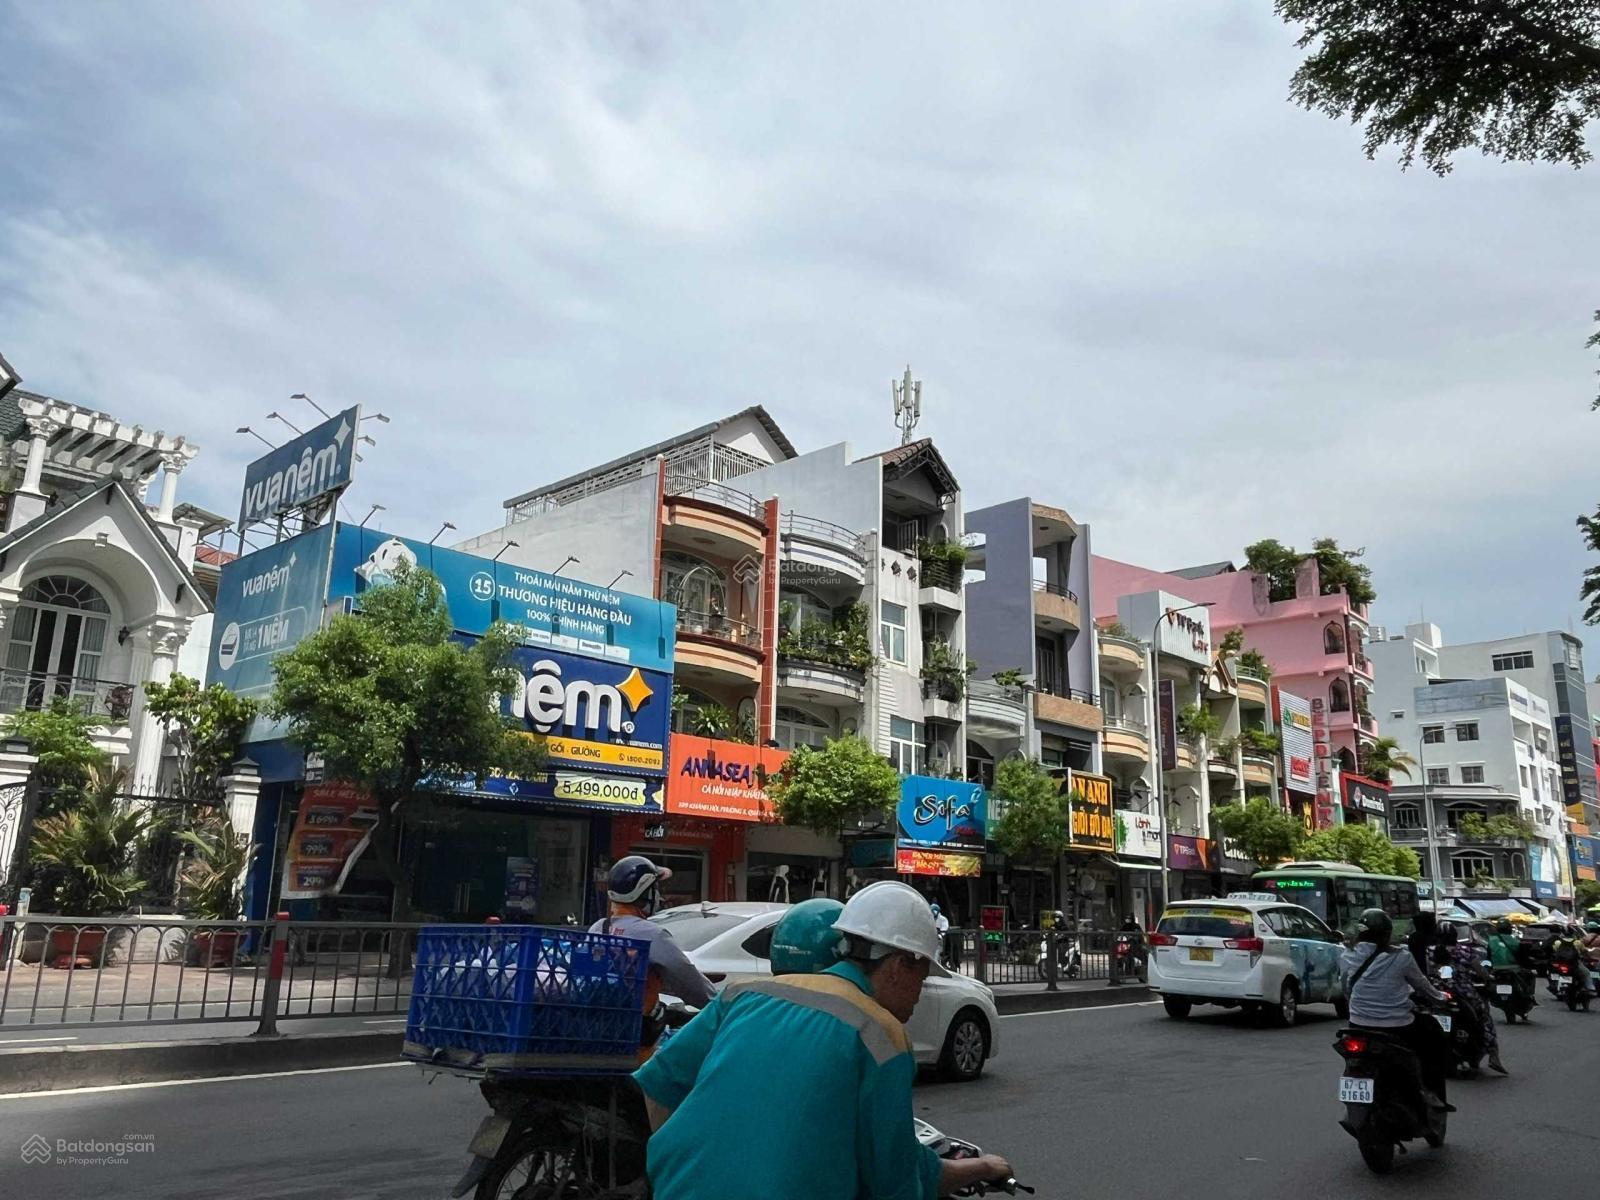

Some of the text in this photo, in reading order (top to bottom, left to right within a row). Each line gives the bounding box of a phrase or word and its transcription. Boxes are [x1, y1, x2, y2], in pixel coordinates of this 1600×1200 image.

[474, 578, 493, 596] 15
[498, 584, 632, 626] THƯƠNG HIỆU HÀNG ĐẦU
[526, 609, 551, 623] 100%
[562, 780, 639, 801] 5.499.000đ
[1341, 1090, 1370, 1101] 91660
